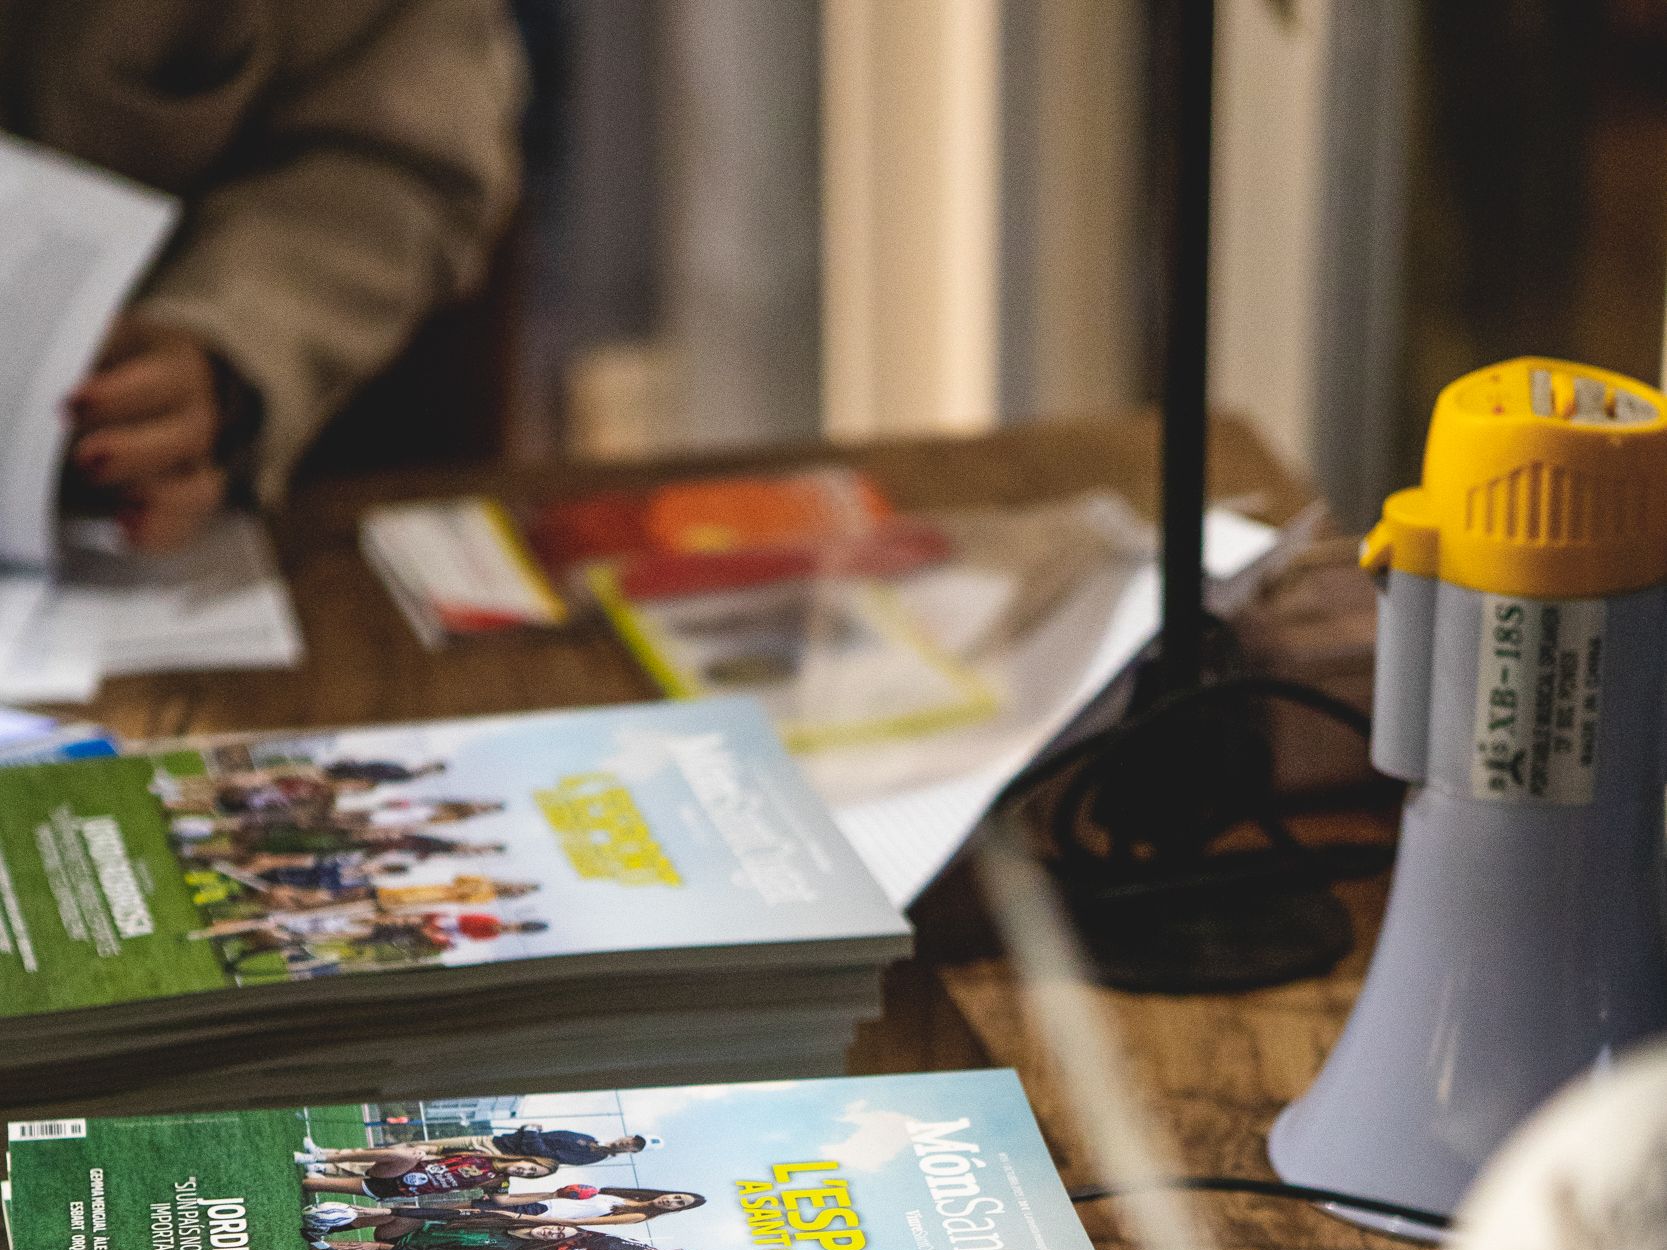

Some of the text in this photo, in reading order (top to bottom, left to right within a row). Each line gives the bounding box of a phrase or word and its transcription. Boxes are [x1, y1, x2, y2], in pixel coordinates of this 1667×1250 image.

[1488, 603, 1524, 736] XB-18S
[89, 1168, 106, 1196] GEMMA
[736, 1180, 763, 1194] A
[91, 1197, 108, 1232] MENGUAL
[174, 1193, 199, 1210] UN
[69, 1202, 84, 1230] ESBART
[177, 1211, 204, 1235] PAÍS
[740, 1196, 790, 1247] SANT
